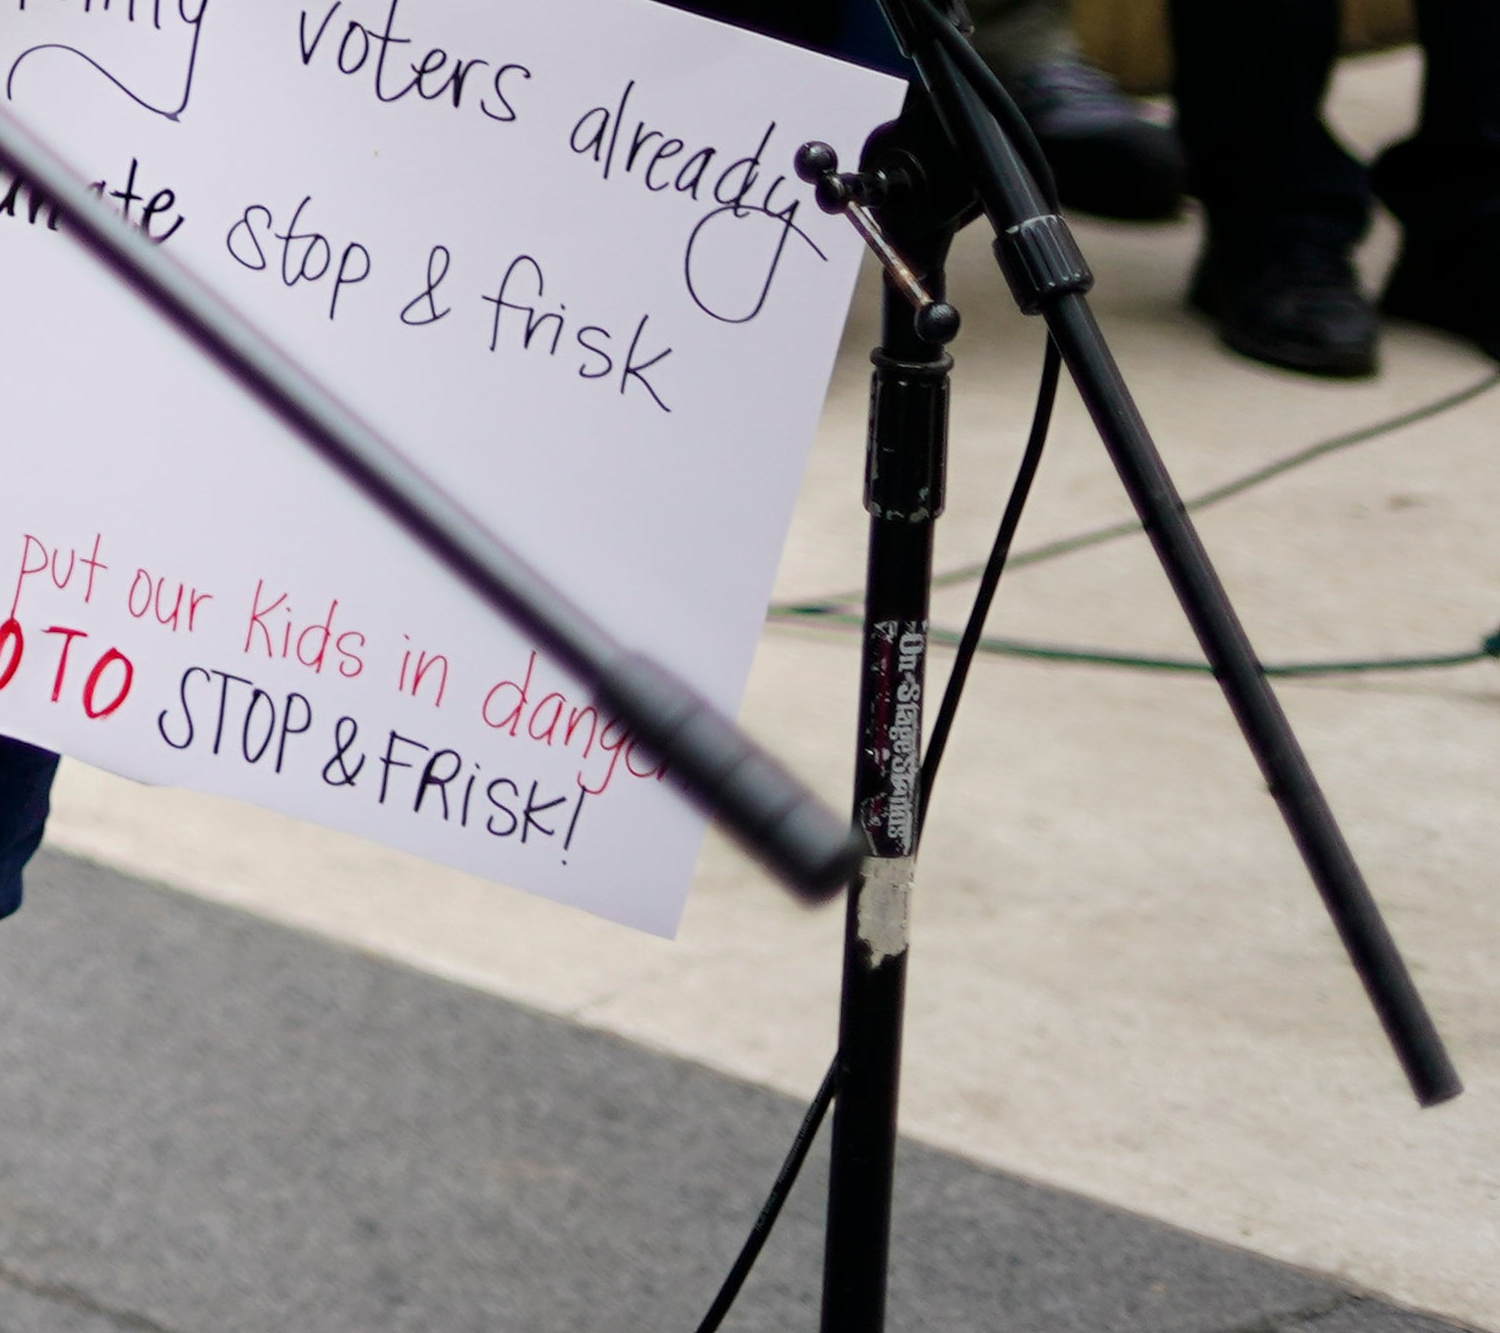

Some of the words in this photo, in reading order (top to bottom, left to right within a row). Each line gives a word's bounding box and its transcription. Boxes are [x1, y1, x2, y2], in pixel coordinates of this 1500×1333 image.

[227, 195, 371, 319] stop
[400, 244, 451, 325] &
[481, 254, 676, 412] frisk
[569, 80, 828, 324] already
[10, 532, 108, 623] put
[128, 568, 213, 632] our
[398, 634, 449, 707] in
[482, 650, 690, 796] dang
[43, 625, 135, 721] TO
[157, 666, 313, 775] STOP
